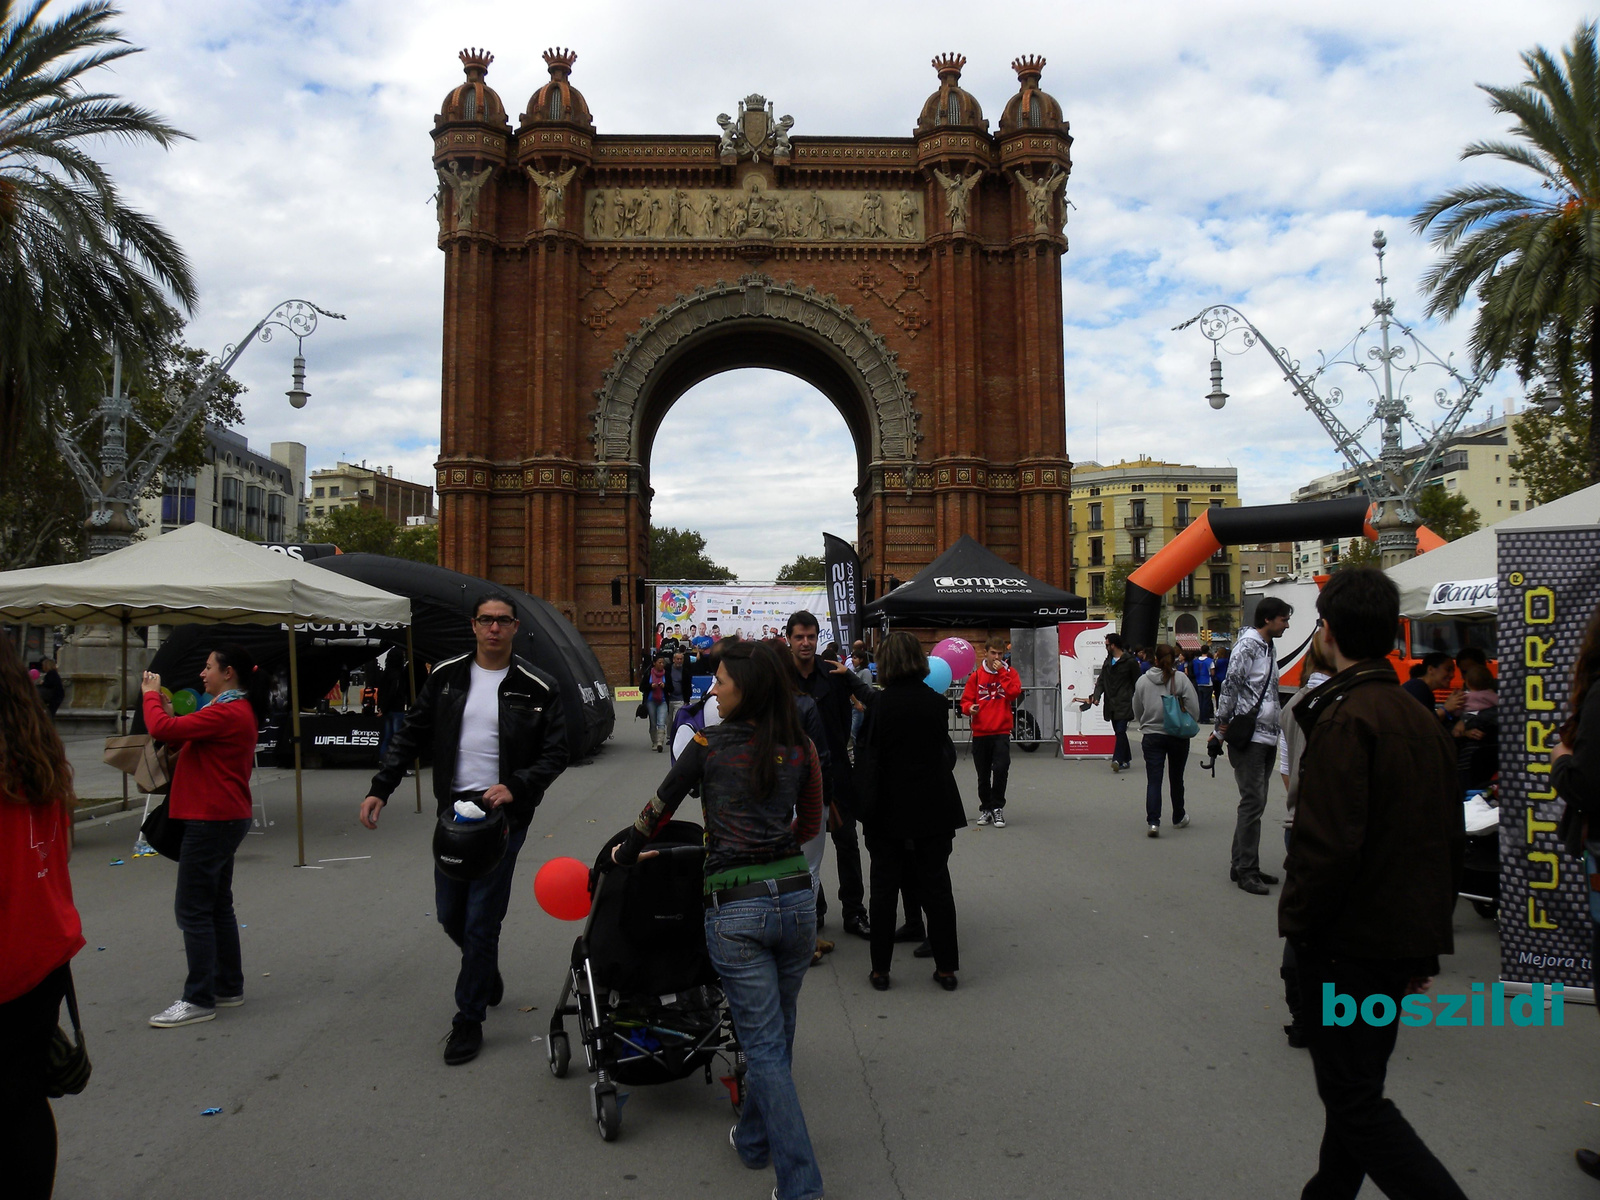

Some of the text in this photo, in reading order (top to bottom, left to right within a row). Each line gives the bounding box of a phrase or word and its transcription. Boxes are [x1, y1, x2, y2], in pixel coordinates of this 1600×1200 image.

[933, 577, 1028, 588] Compex
[976, 587, 1033, 595] intelligence
[1433, 580, 1498, 605] Compe
[1038, 607, 1069, 615] DJO
[314, 736, 380, 746] WIRELESS
[1519, 952, 1575, 968] Mejora
